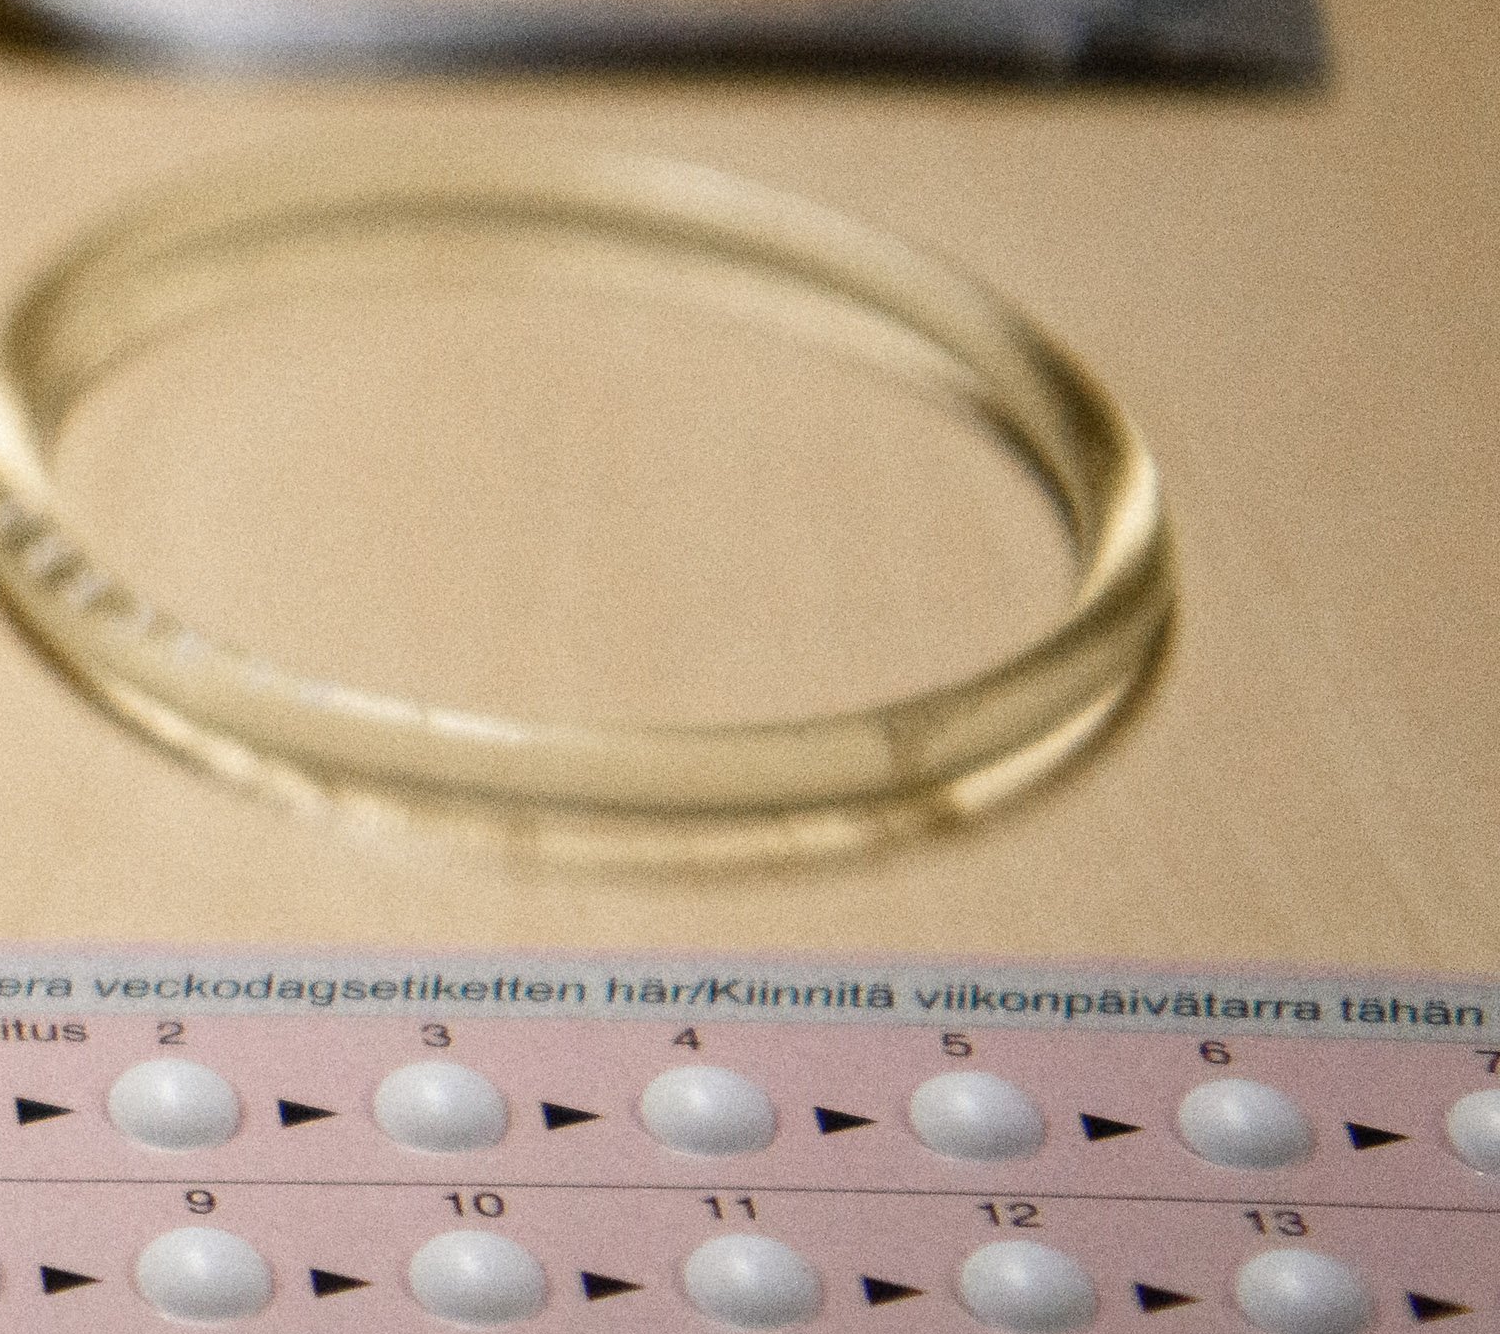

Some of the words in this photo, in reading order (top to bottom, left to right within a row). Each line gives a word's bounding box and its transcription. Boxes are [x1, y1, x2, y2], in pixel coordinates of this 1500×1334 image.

[94, 971, 589, 1008] veckodagsetiketten
[604, 975, 895, 1011] här/Kiinnitä
[915, 980, 1324, 1024] viikonpäivätarra
[1342, 994, 1485, 1028] tähän
[156, 1020, 187, 1047] 2
[421, 1023, 454, 1049] 3
[671, 1028, 703, 1053] 4
[942, 1031, 973, 1058] 5
[1198, 1040, 1232, 1066] 6
[1474, 1049, 1500, 1075] 7
[184, 1189, 218, 1216] 9
[445, 1191, 504, 1219] 10
[703, 1195, 758, 1222] 11
[978, 1201, 1042, 1229] 12
[1245, 1209, 1306, 1238] 13
